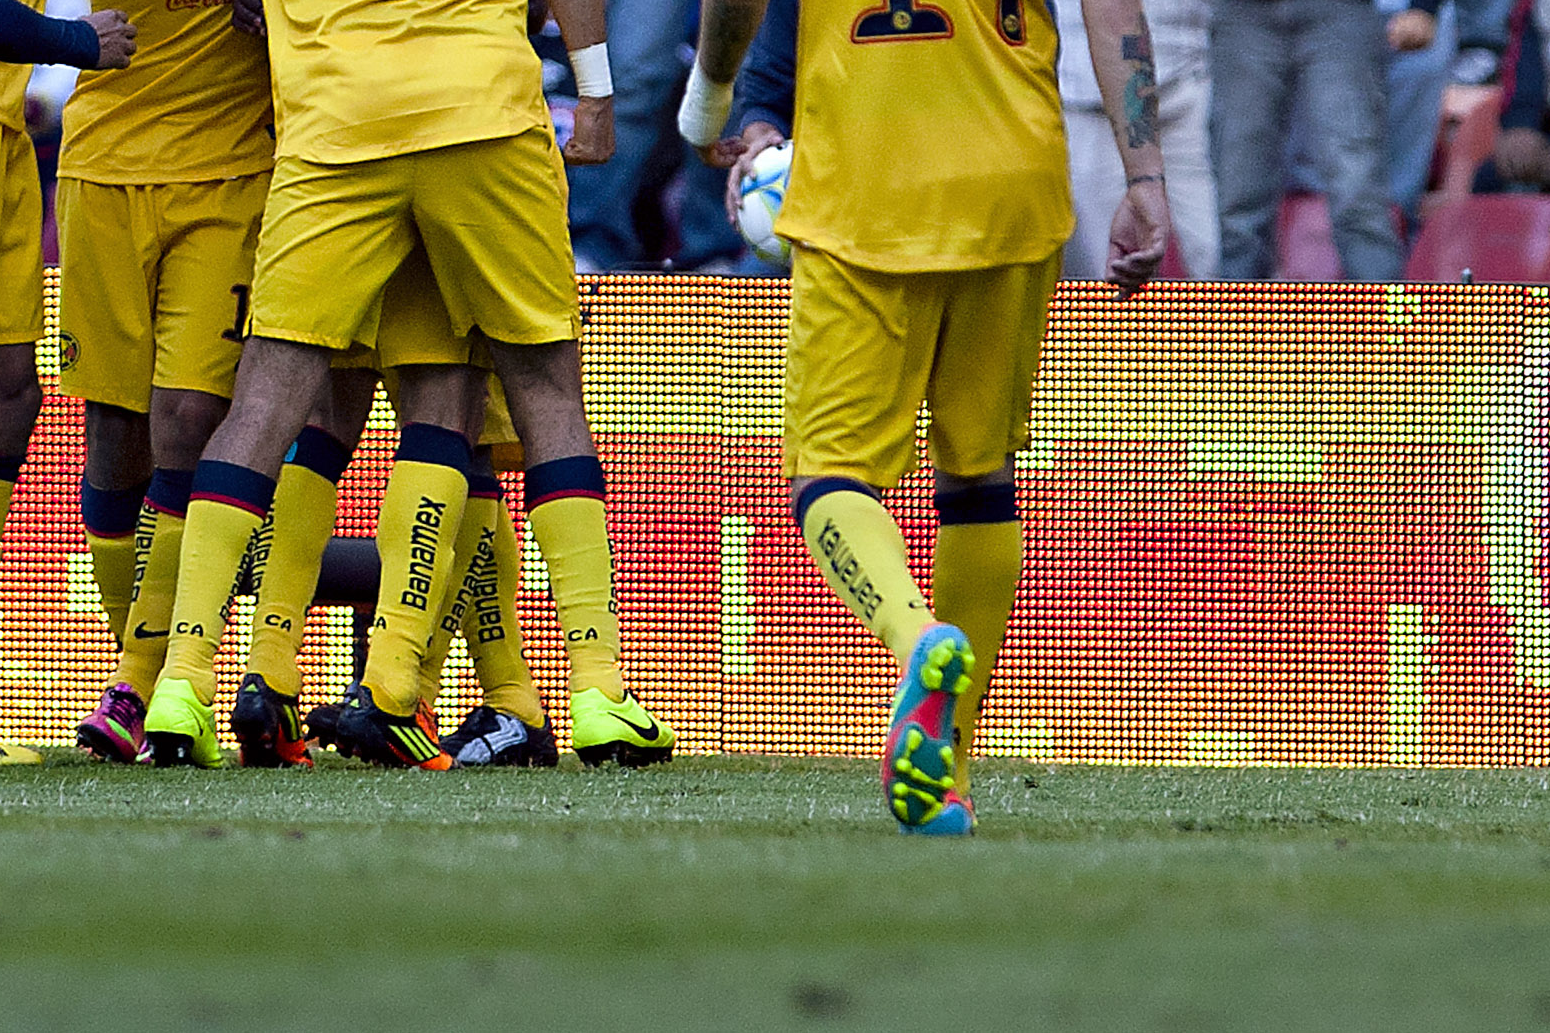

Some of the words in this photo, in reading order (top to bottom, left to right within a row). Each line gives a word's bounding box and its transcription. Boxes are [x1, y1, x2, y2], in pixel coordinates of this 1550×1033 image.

[401, 496, 447, 612] Banamex
[440, 526, 496, 634] Banamex
[176, 621, 204, 638] CA
[567, 627, 599, 642] CA
